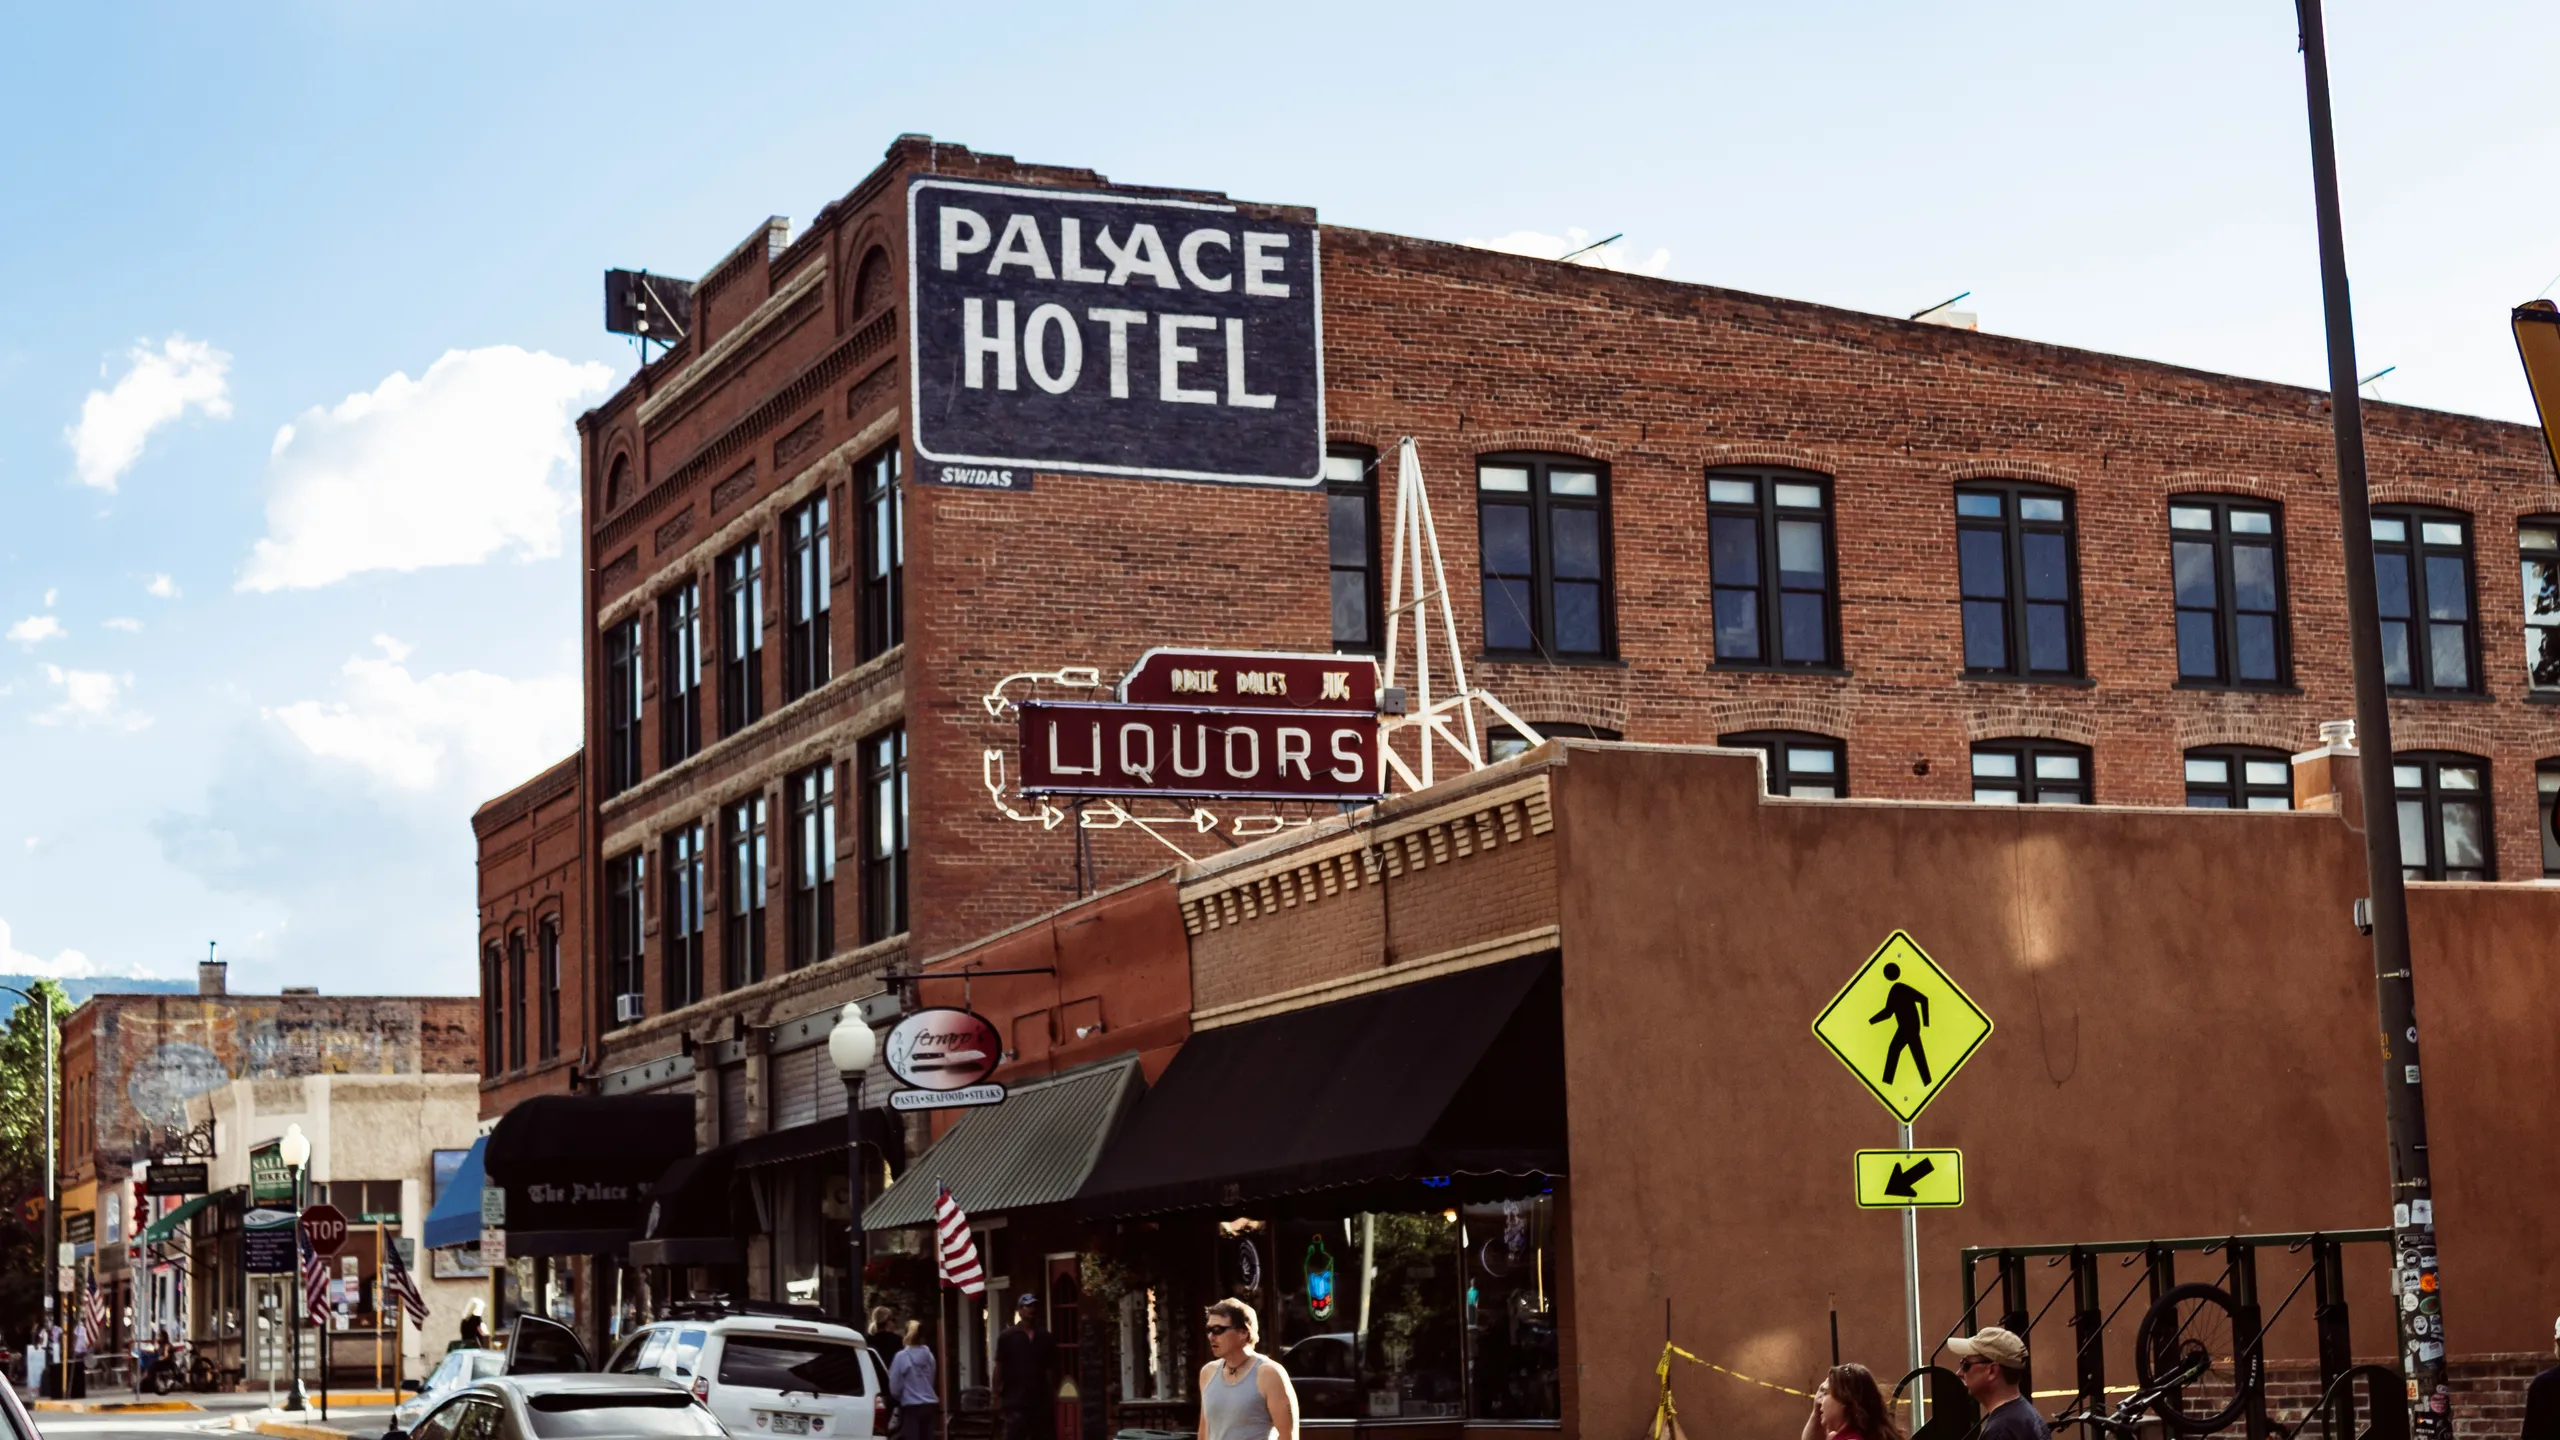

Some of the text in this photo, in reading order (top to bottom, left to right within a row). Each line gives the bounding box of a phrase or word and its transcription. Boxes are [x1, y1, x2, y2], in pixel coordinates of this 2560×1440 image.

[939, 205, 1290, 298] PALACE
[963, 298, 1277, 409] HOTEL
[940, 466, 1013, 487] SWIDAS
[1236, 670, 1288, 696] DALE'S
[1320, 671, 1350, 701] JUG
[1048, 720, 1364, 786] LIQUORS
[894, 1088, 1002, 1106] PASTA SEAFOOD STEAKS
[527, 1183, 565, 1204] The
[571, 1182, 629, 1205] Palace
